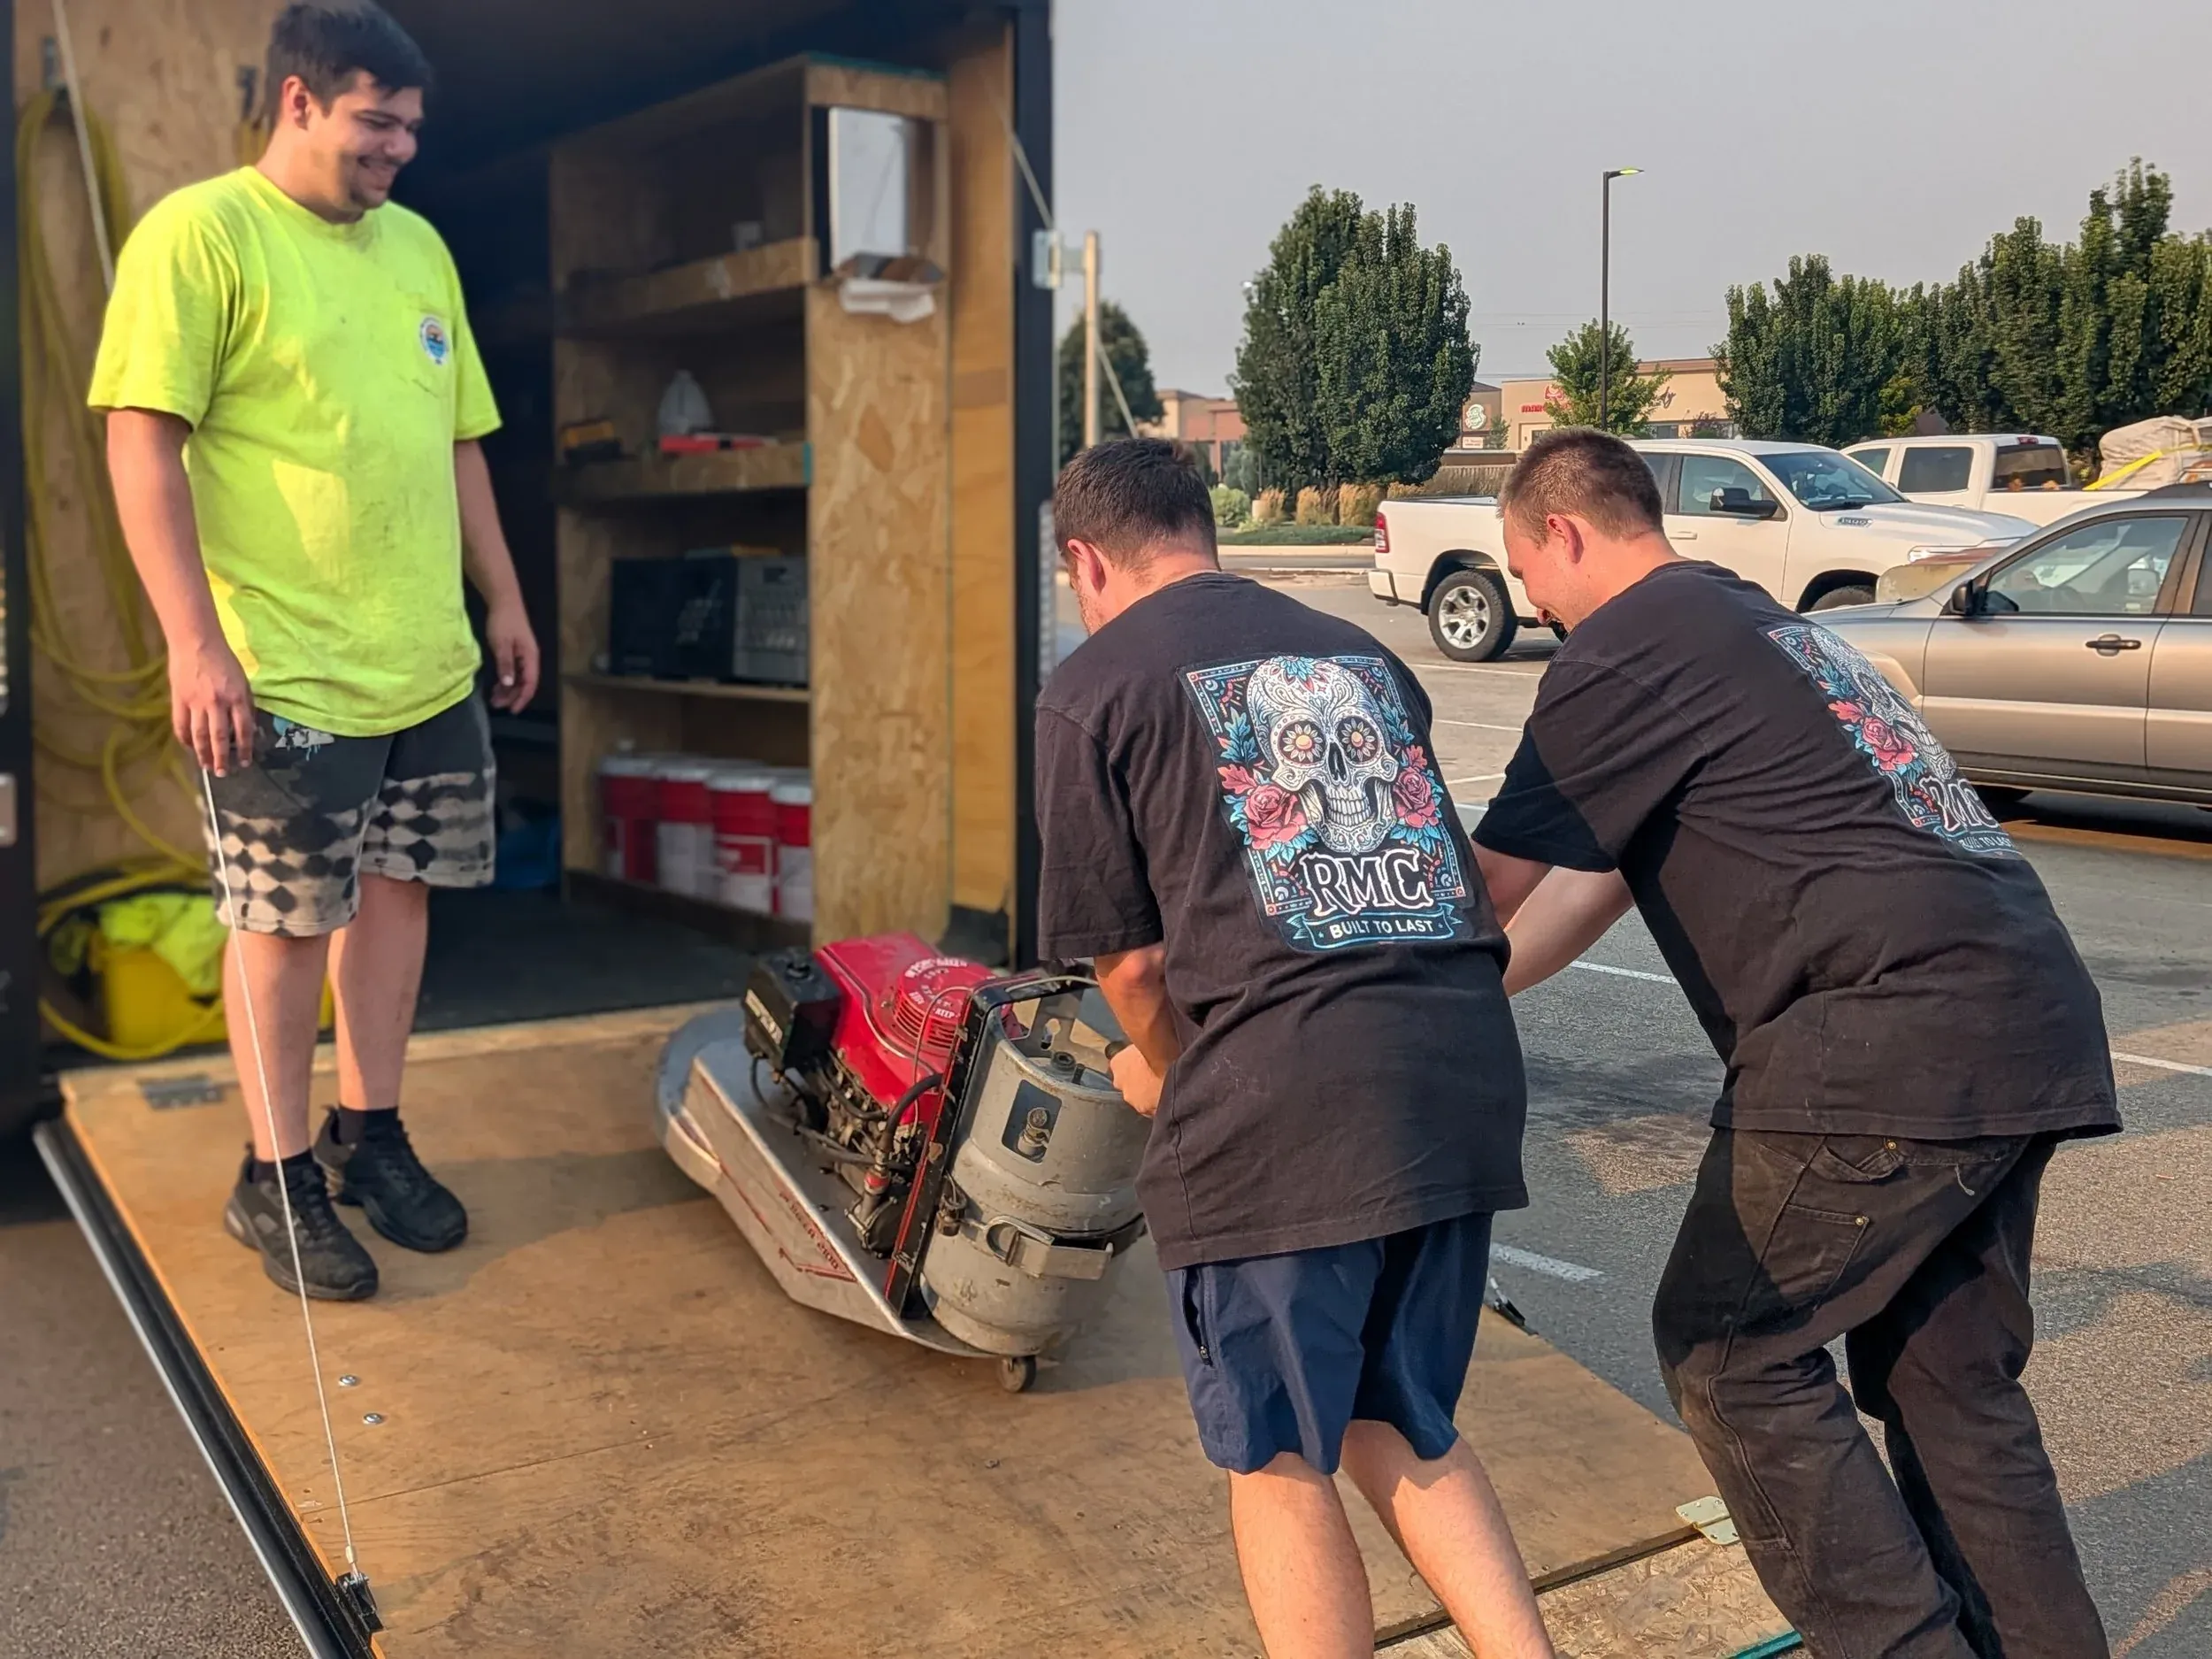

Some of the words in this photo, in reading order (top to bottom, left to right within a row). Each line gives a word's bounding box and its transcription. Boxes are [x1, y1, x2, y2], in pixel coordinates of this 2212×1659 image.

[1299, 848, 1434, 917] RMC
[1329, 920, 1371, 939] BUILT
[1372, 920, 1393, 933] TO
[1395, 919, 1433, 933] LAST
